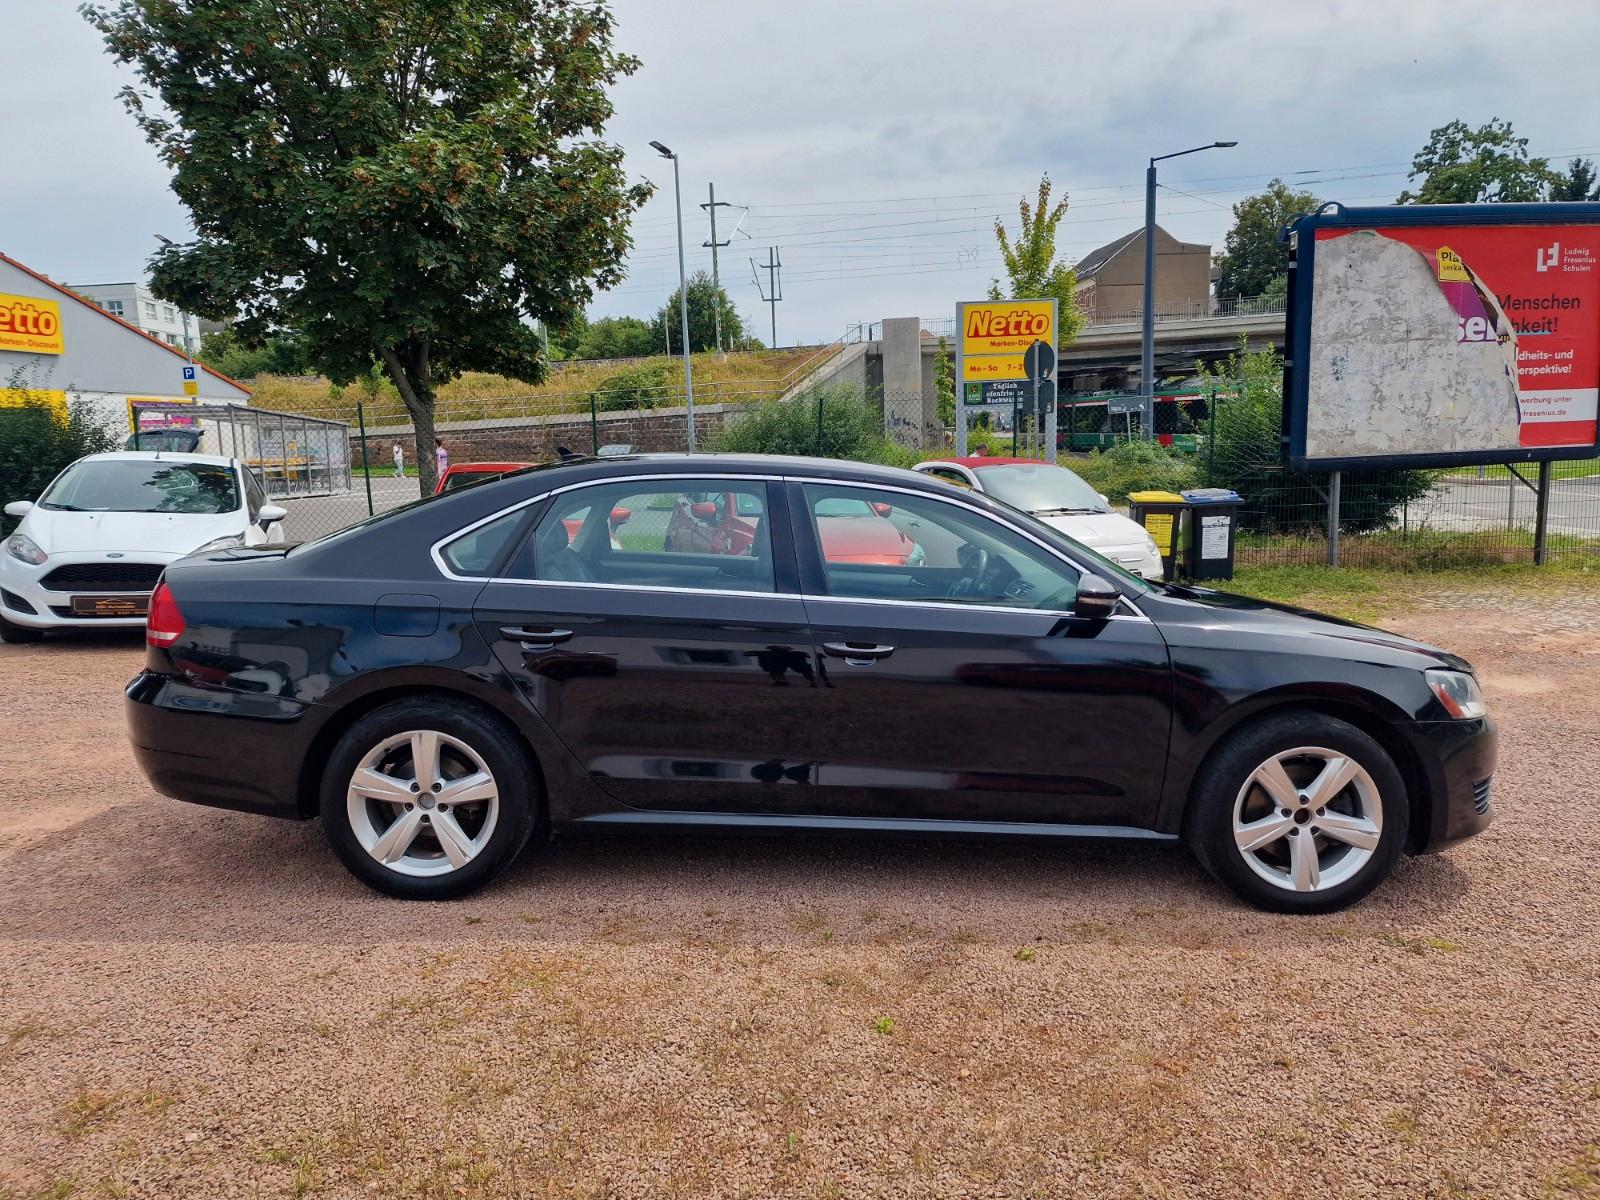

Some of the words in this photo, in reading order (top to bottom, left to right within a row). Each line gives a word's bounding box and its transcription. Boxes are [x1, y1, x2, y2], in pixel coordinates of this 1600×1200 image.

[1564, 247, 1590, 256] Ludwig
[1562, 264, 1591, 272] Schulen
[1498, 294, 1581, 310] Menschen
[0, 302, 57, 336] etto
[967, 310, 1049, 338] Netto
[1510, 316, 1559, 333] hkeit!
[1516, 346, 1553, 361] dheits-
[1554, 349, 1574, 360] und
[185, 367, 193, 379] P
[1517, 364, 1572, 376] erspektive!
[992, 382, 1018, 390] Täglich
[1520, 397, 1552, 405] werbung
[1520, 409, 1567, 417] -fresenius.de
